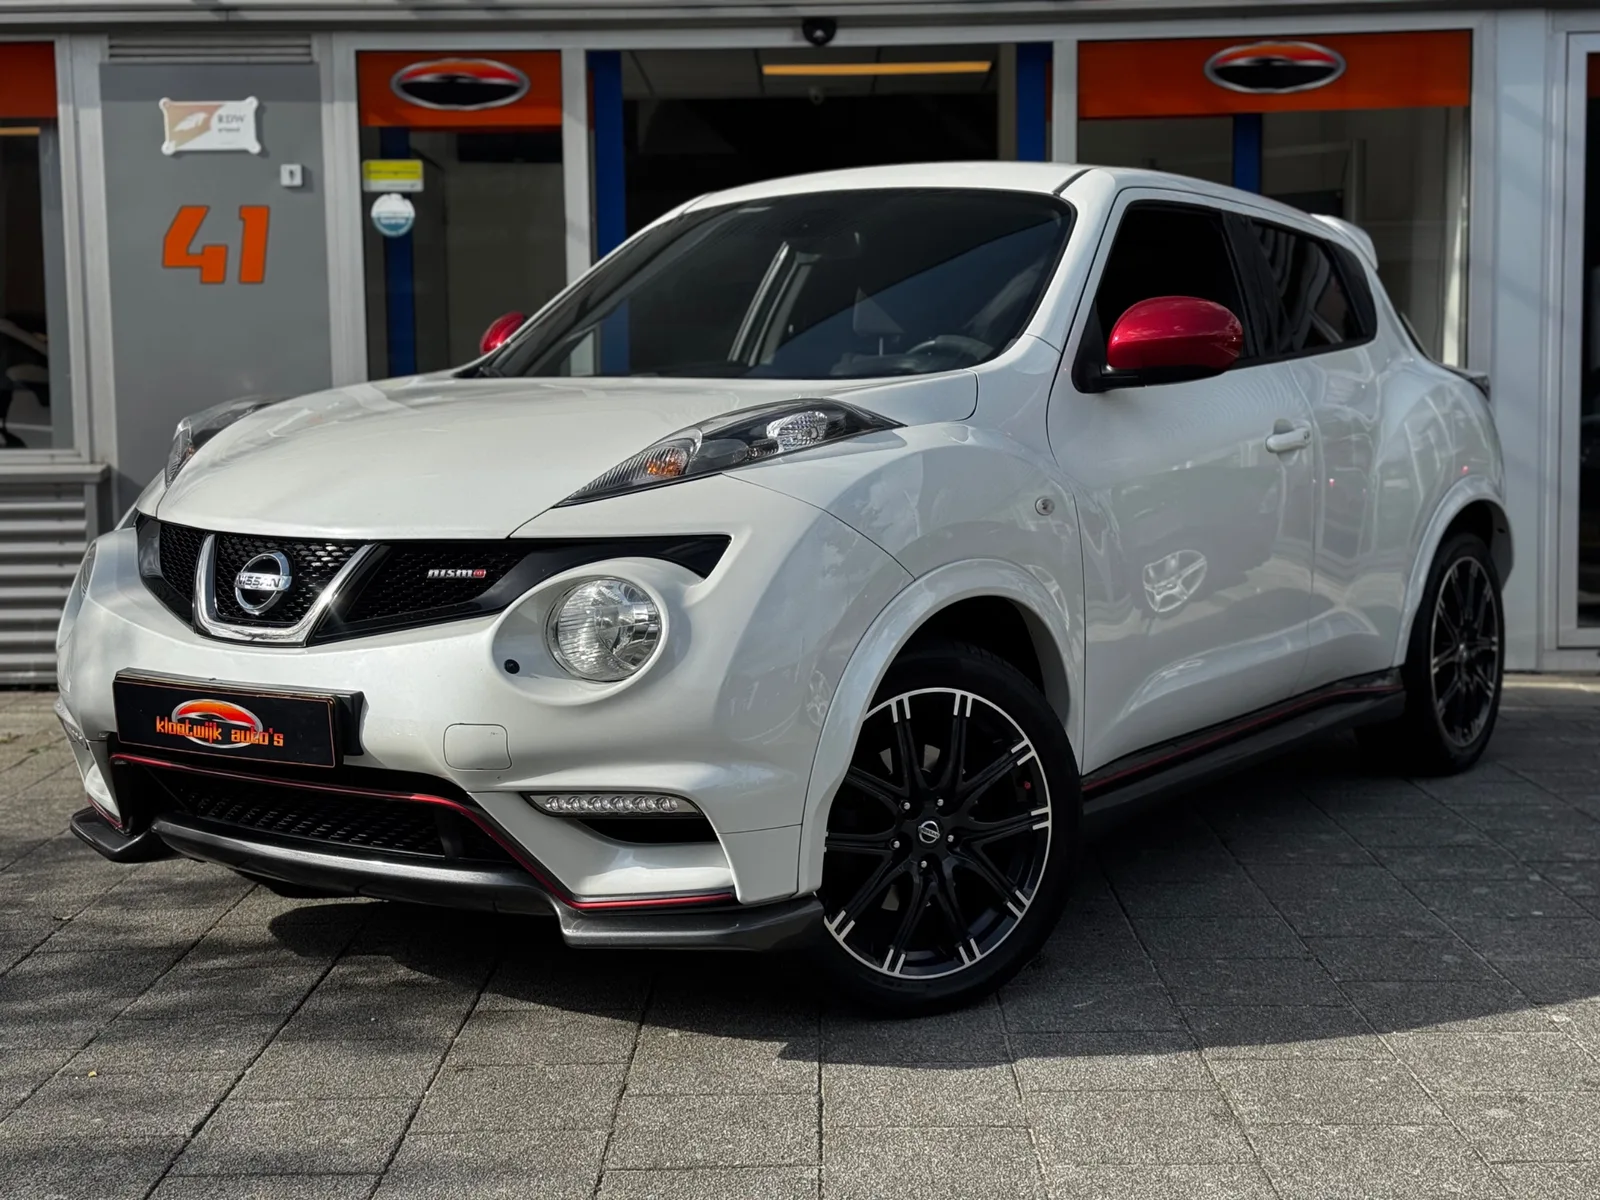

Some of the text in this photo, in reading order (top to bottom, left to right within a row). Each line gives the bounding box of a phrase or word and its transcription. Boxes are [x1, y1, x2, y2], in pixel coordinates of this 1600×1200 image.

[162, 205, 269, 284] 41
[156, 716, 283, 746] klootwijk auto's
